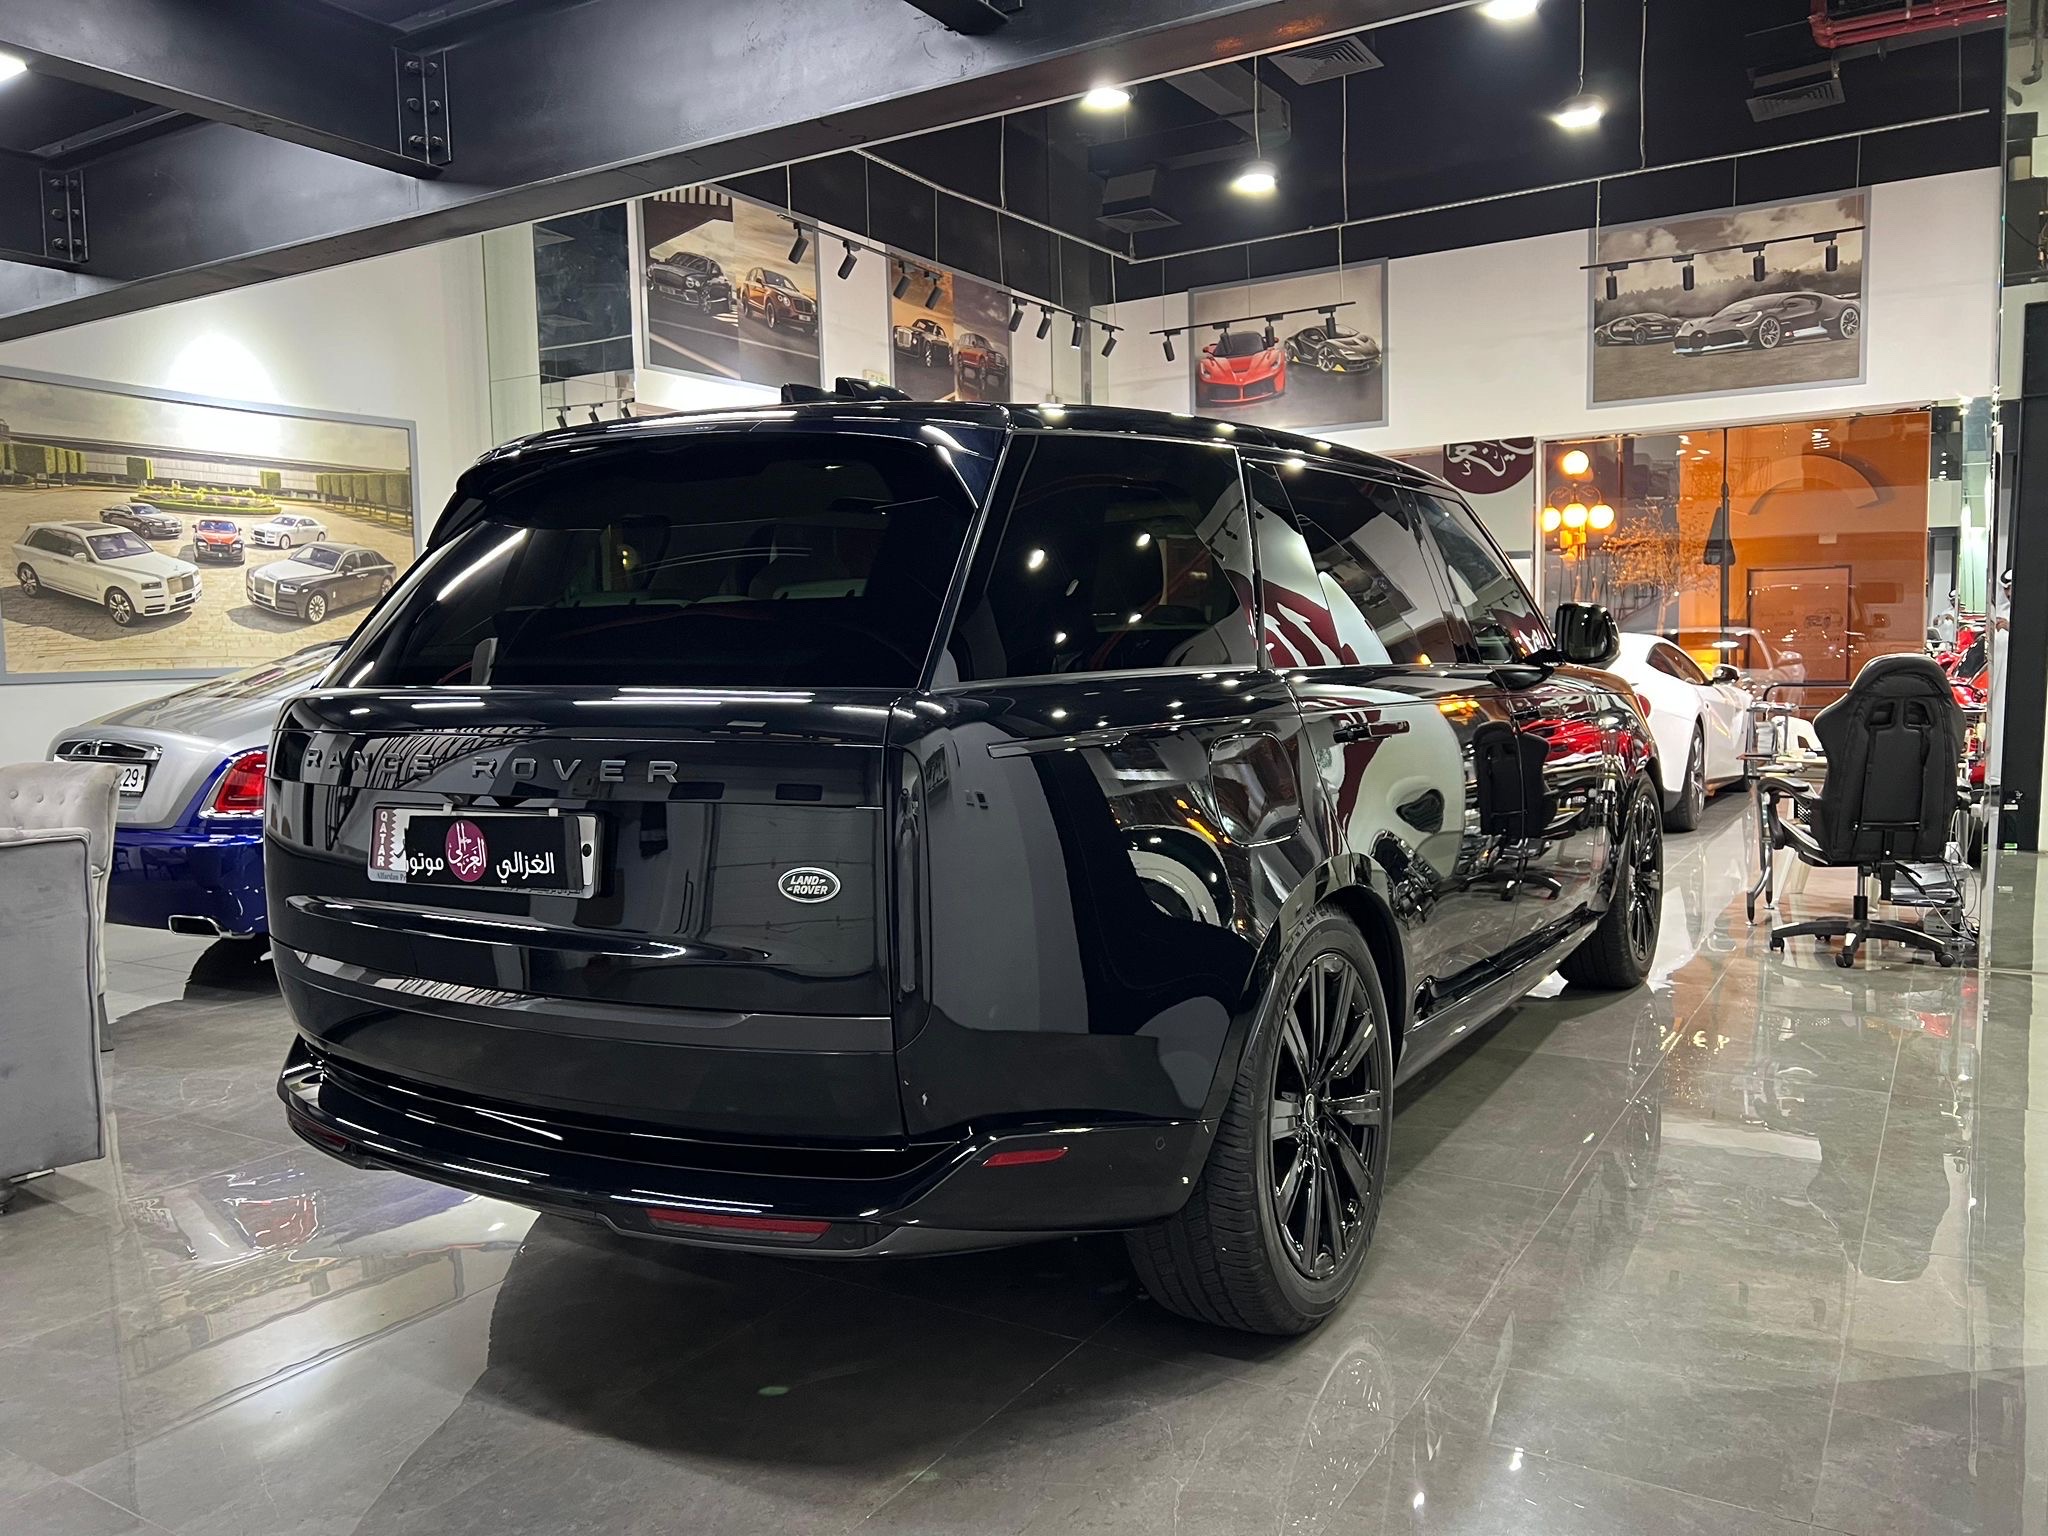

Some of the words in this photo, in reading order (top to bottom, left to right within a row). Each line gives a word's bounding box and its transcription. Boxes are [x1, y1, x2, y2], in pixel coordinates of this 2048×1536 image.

[120, 768, 139, 787] 29
[306, 748, 434, 776] RANGE
[471, 757, 679, 784] ROVER
[376, 811, 388, 867] QATAR
[496, 851, 555, 884] الغزالي
[790, 875, 819, 885] LAND
[792, 885, 828, 895] ROVER
